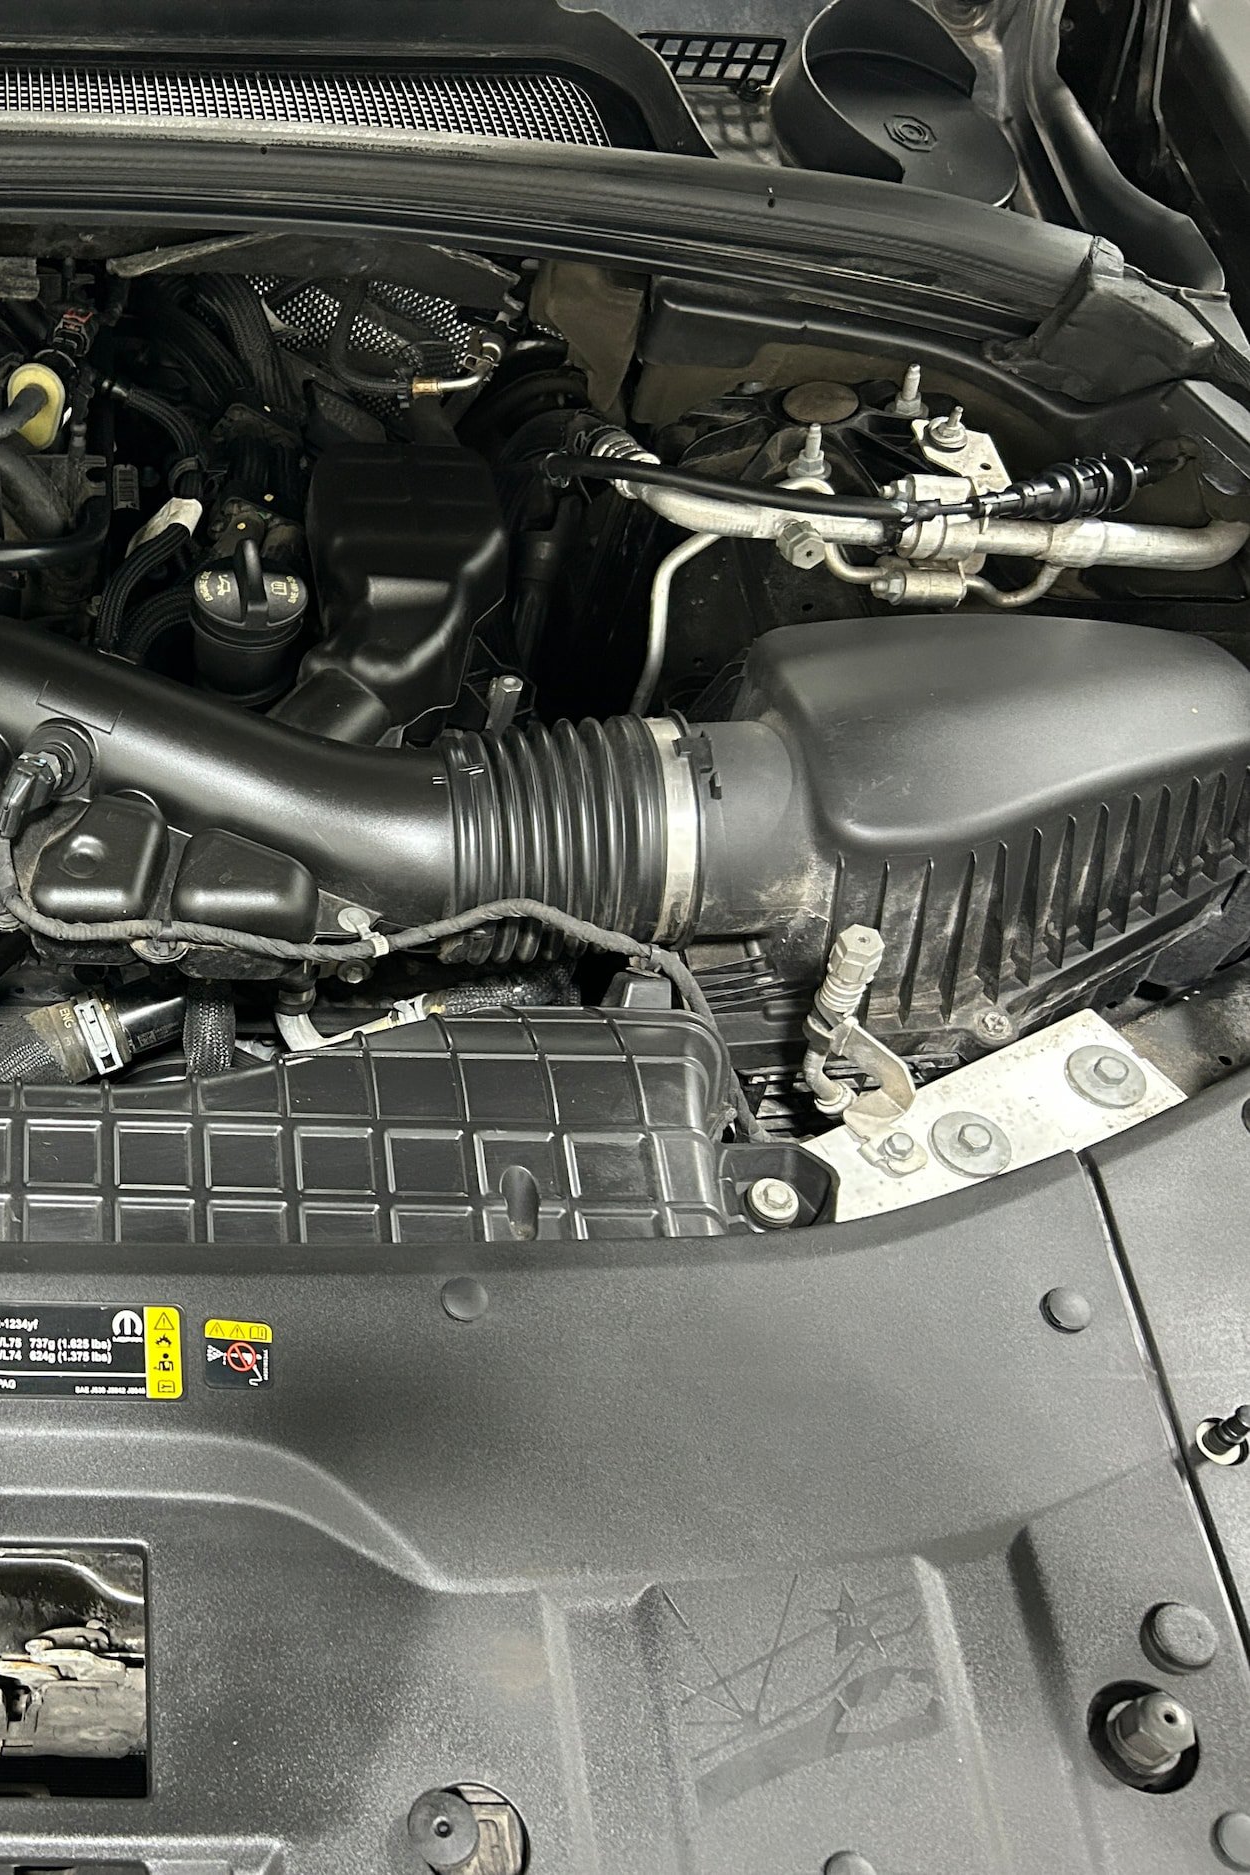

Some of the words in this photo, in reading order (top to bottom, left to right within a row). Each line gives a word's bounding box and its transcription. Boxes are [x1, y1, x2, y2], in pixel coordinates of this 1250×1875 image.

[199, 580, 213, 601] ENGINE
[59, 1007, 75, 1029] ENG
[29, 1338, 56, 1350] 737g
[57, 1338, 90, 1351] (1.625
[91, 1338, 112, 1351] lbs)
[29, 1350, 56, 1363] 624g
[57, 1350, 90, 1364] (1.375
[91, 1351, 112, 1364] lbs)
